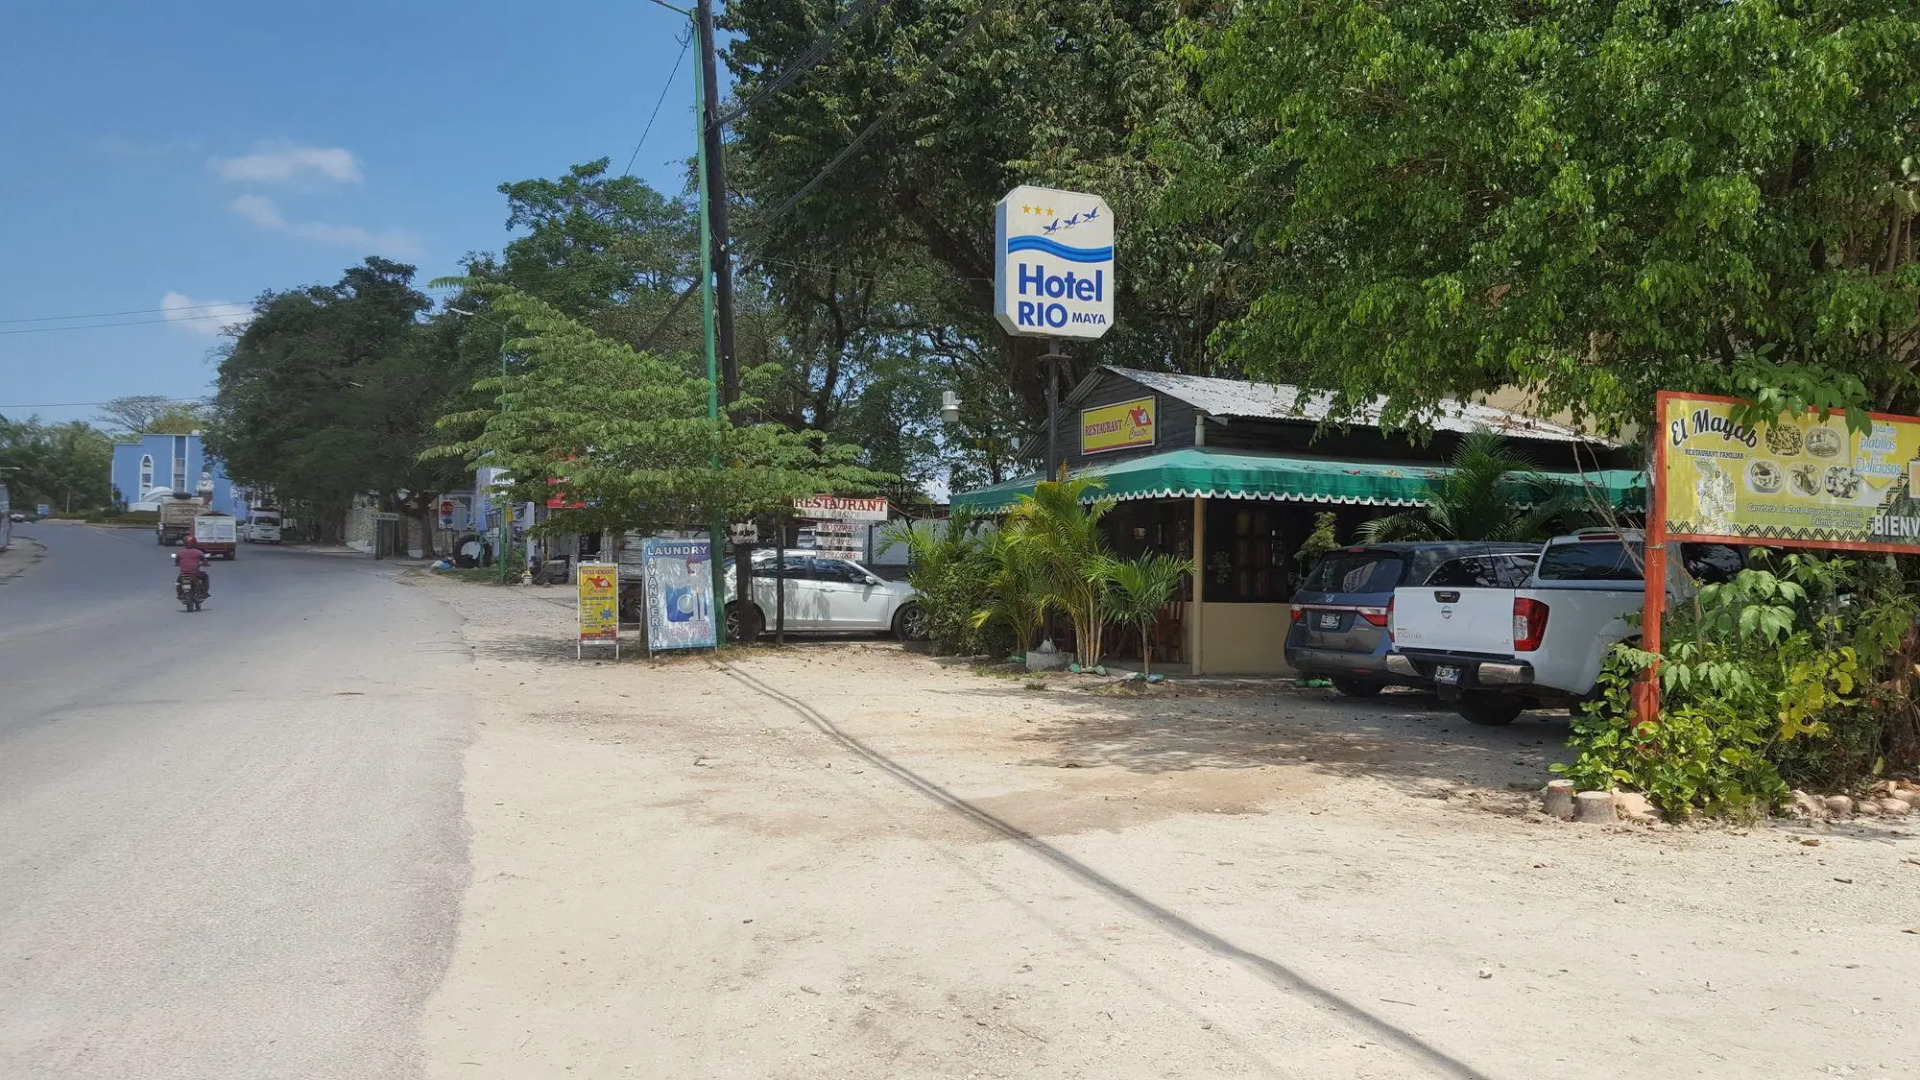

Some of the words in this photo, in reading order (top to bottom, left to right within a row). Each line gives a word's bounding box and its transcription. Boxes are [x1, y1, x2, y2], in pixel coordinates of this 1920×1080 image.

[1018, 263, 1103, 302] Hotel
[1018, 301, 1068, 328] RIO
[1072, 312, 1106, 325] MAYA
[1085, 420, 1122, 437] RESTAURANT
[1671, 418, 1688, 446] El
[1692, 409, 1757, 448] Mayab
[1685, 449, 1718, 458] RESTAURANT
[1719, 451, 1744, 459] FAMILIAR
[794, 496, 887, 512] RESTAURANT
[647, 546, 707, 556] LAUNDRY
